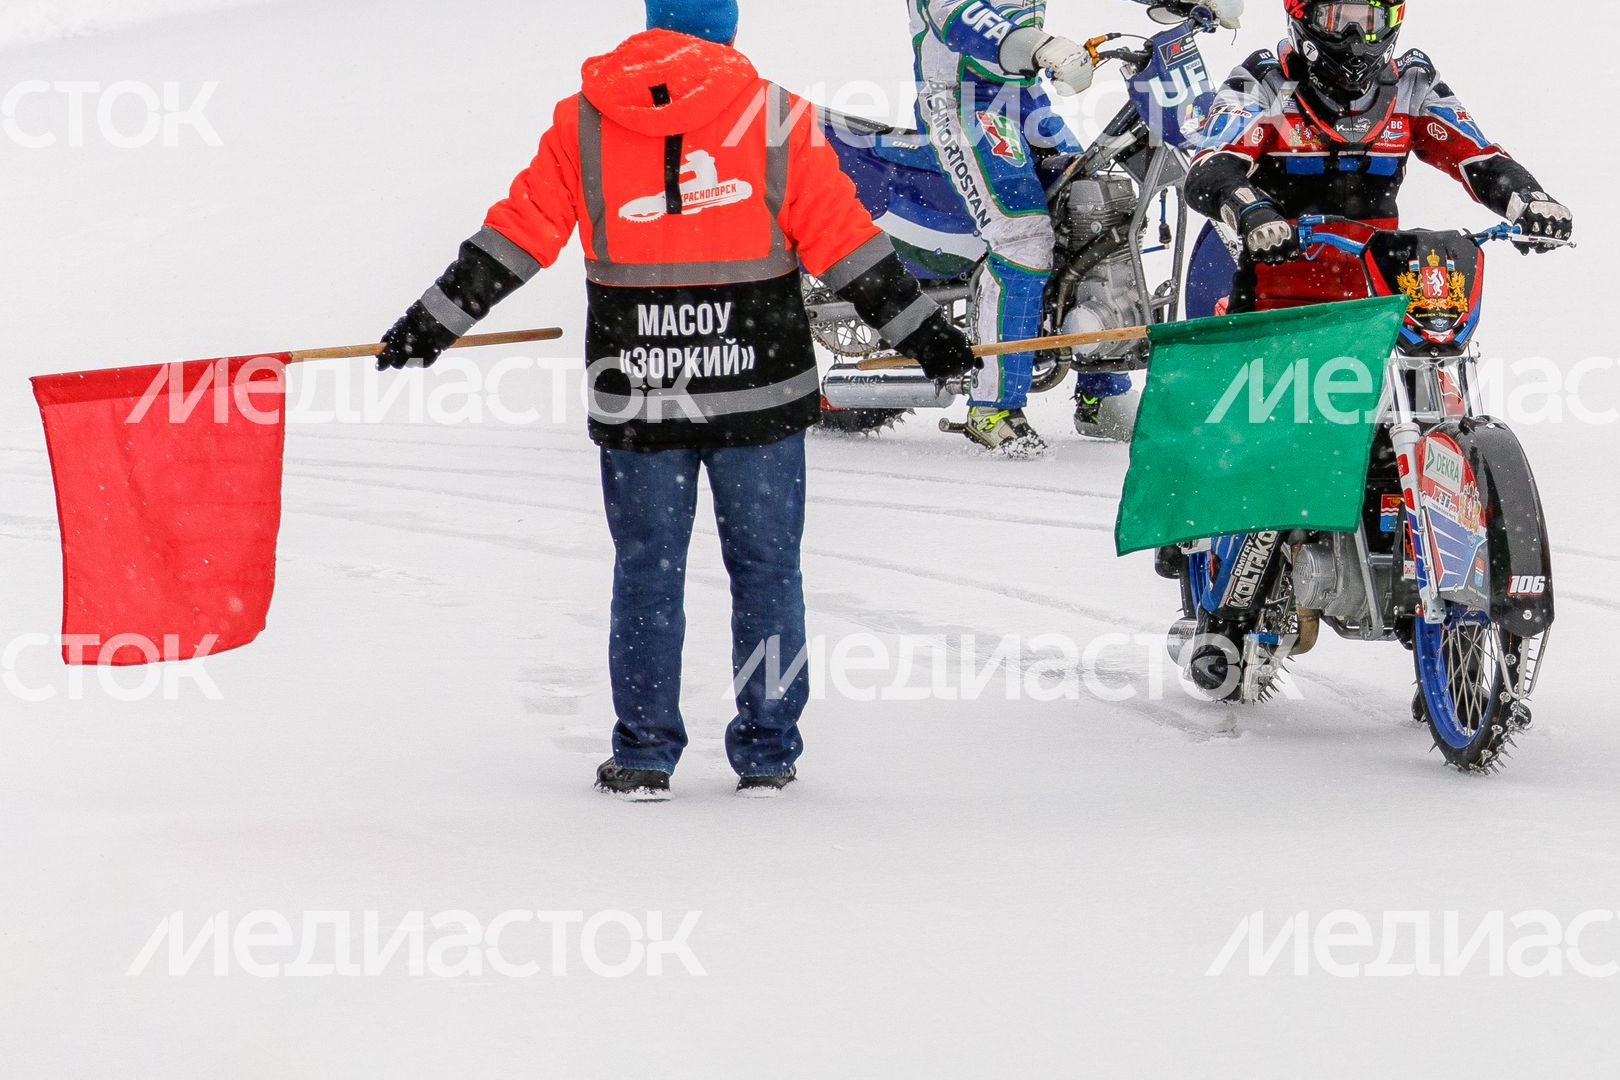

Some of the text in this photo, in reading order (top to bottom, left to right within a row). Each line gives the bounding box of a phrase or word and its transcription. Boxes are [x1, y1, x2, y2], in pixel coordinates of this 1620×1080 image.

[961, 0, 1012, 45] UFA
[1148, 58, 1216, 108] UF
[637, 301, 732, 336] МАСОУ
[619, 337, 756, 379] «ЗОРКИЙ»
[1436, 452, 1460, 484] DEKRA
[1508, 575, 1546, 595] 106
